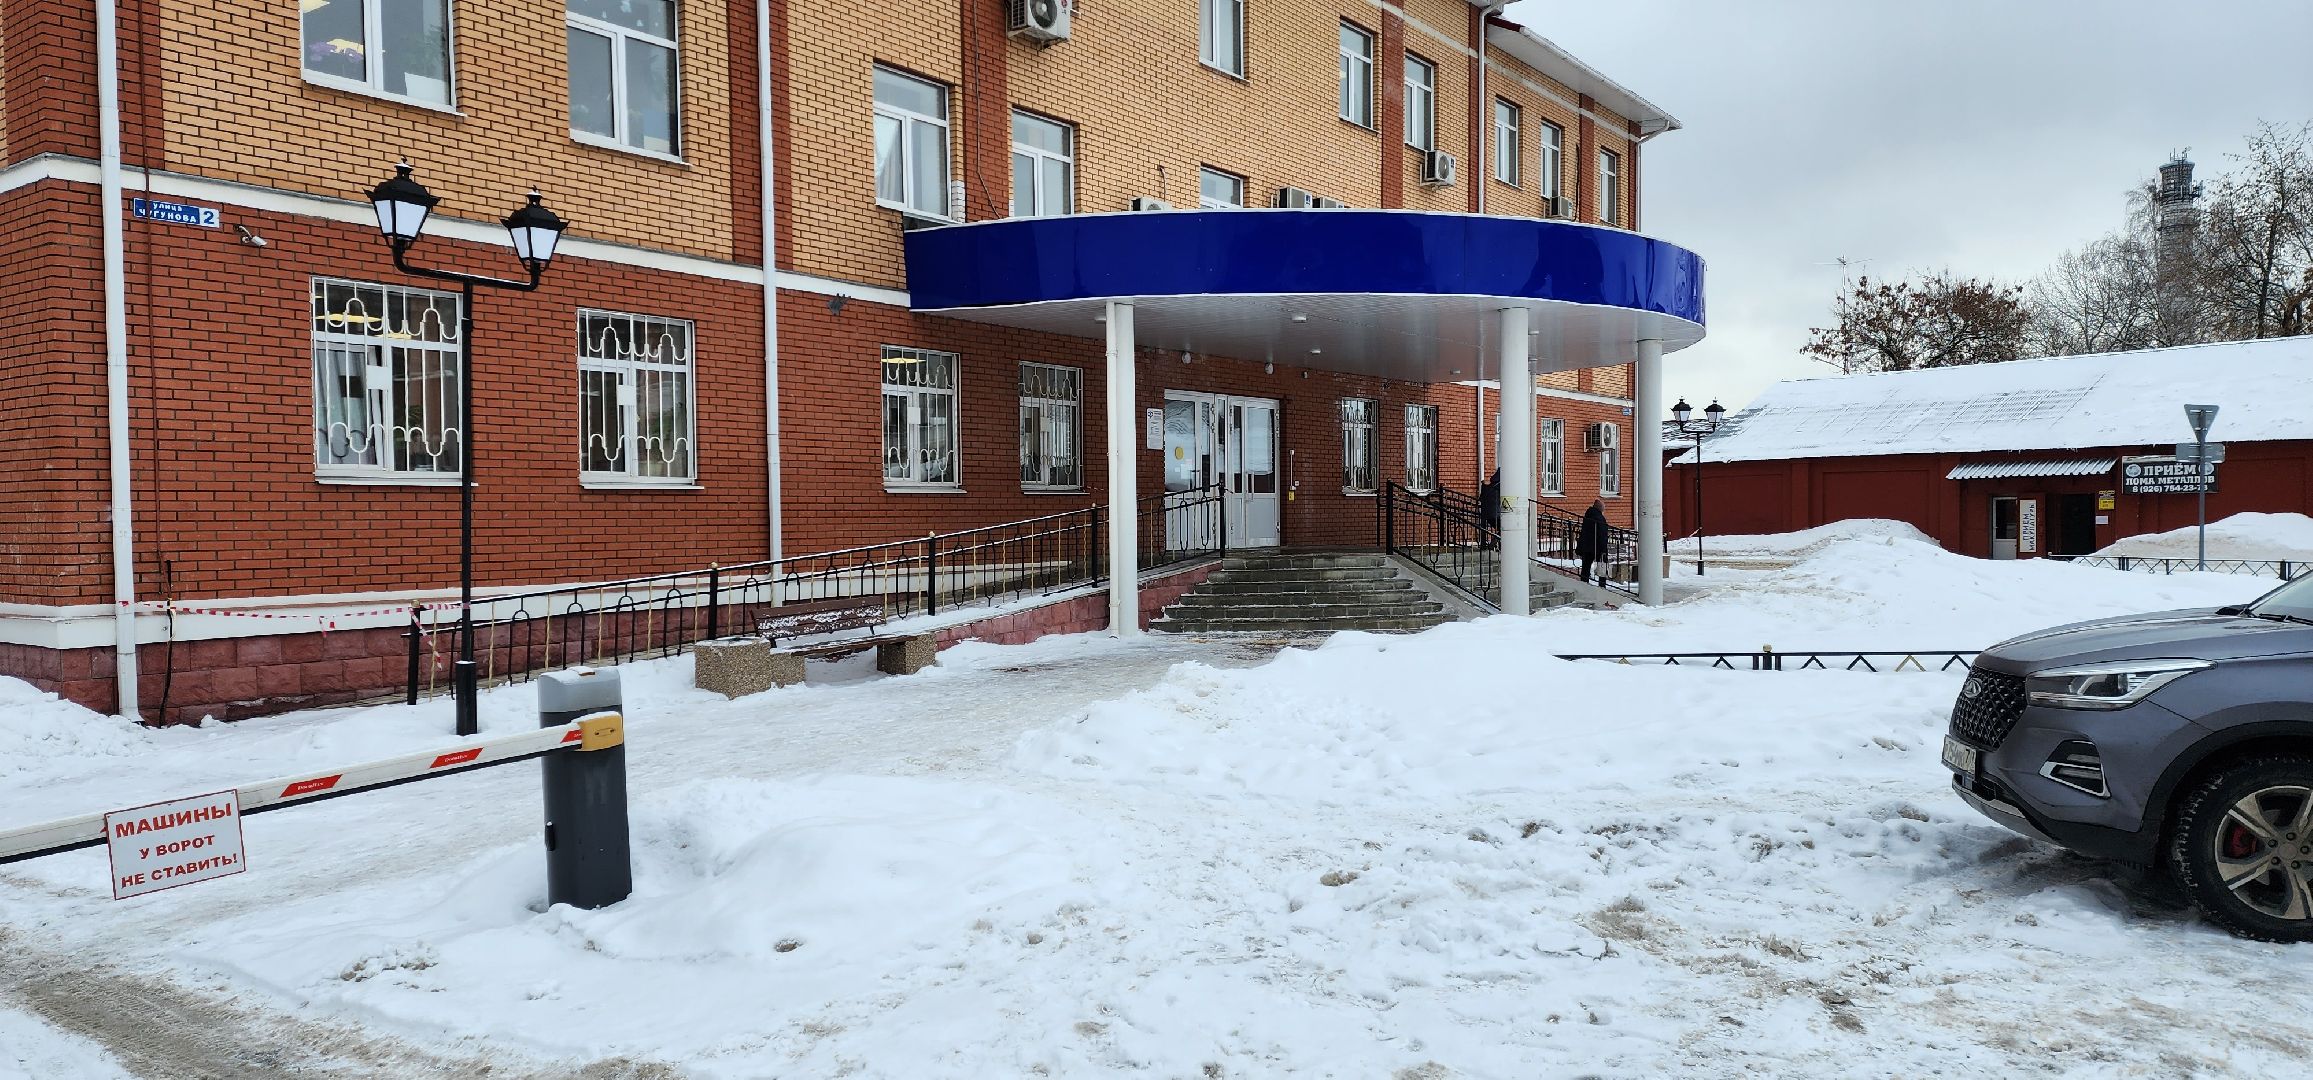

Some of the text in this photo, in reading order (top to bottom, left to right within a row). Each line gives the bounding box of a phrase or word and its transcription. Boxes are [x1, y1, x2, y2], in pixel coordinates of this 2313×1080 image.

[152, 202, 182, 212] улица
[203, 210, 214, 225] 2
[2143, 462, 2197, 476] ПРИЁМ
[2125, 477, 2155, 486] ЛОМА
[2140, 485, 2162, 494] (926)
[115, 803, 232, 839] МАШИНЫ
[156, 834, 215, 857] ВОРОТ
[121, 853, 238, 889] НЕ СТАВИТЬ!
